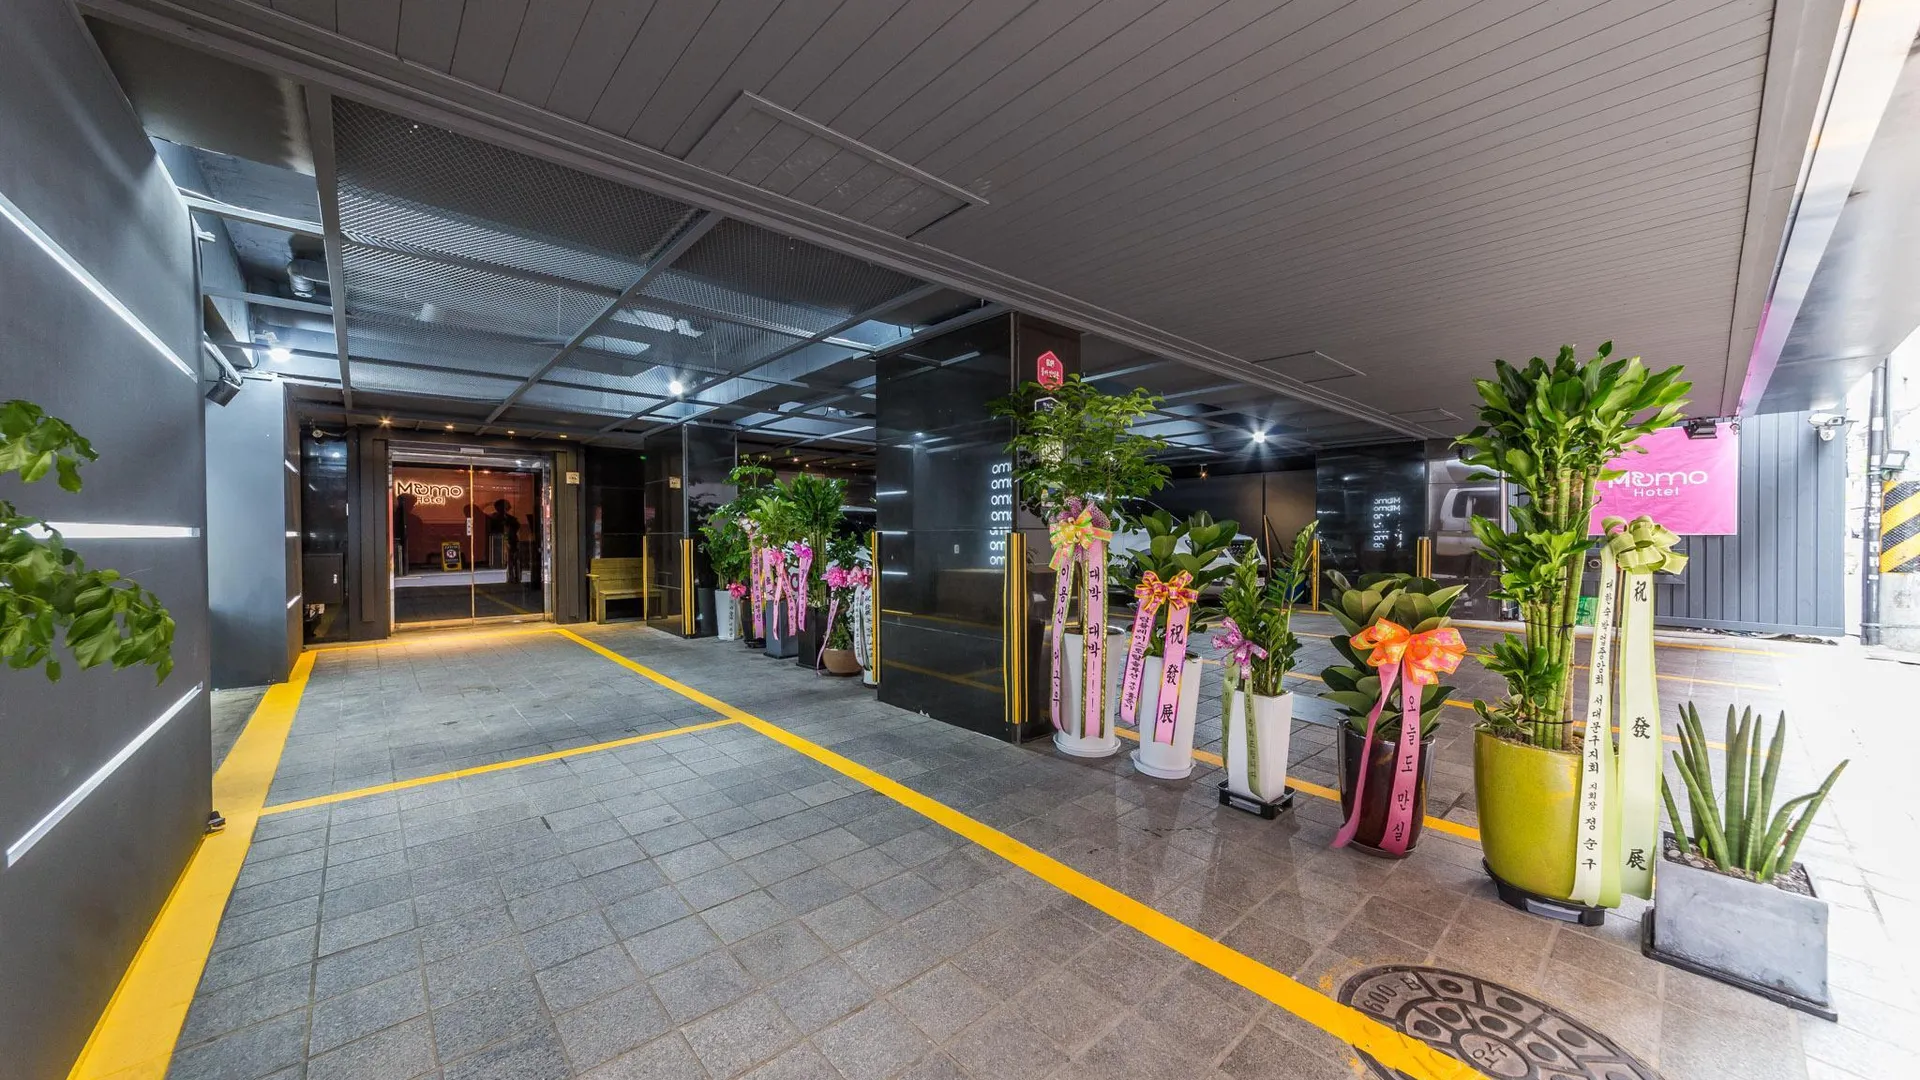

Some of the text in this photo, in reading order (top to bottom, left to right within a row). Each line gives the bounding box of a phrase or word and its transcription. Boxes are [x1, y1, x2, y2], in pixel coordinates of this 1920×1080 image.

[396, 481, 463, 498] Momo
[1608, 470, 1708, 489] Momo
[1634, 487, 1679, 497] Hotel
[416, 496, 446, 506] Hotel
[1088, 566, 1101, 602] 대박
[1160, 623, 1184, 723] 祝發展
[1588, 694, 1603, 774] 서대문구지회
[1588, 782, 1598, 811] 지회장
[1392, 790, 1410, 842] 만실
[1582, 817, 1598, 871] 정순구
